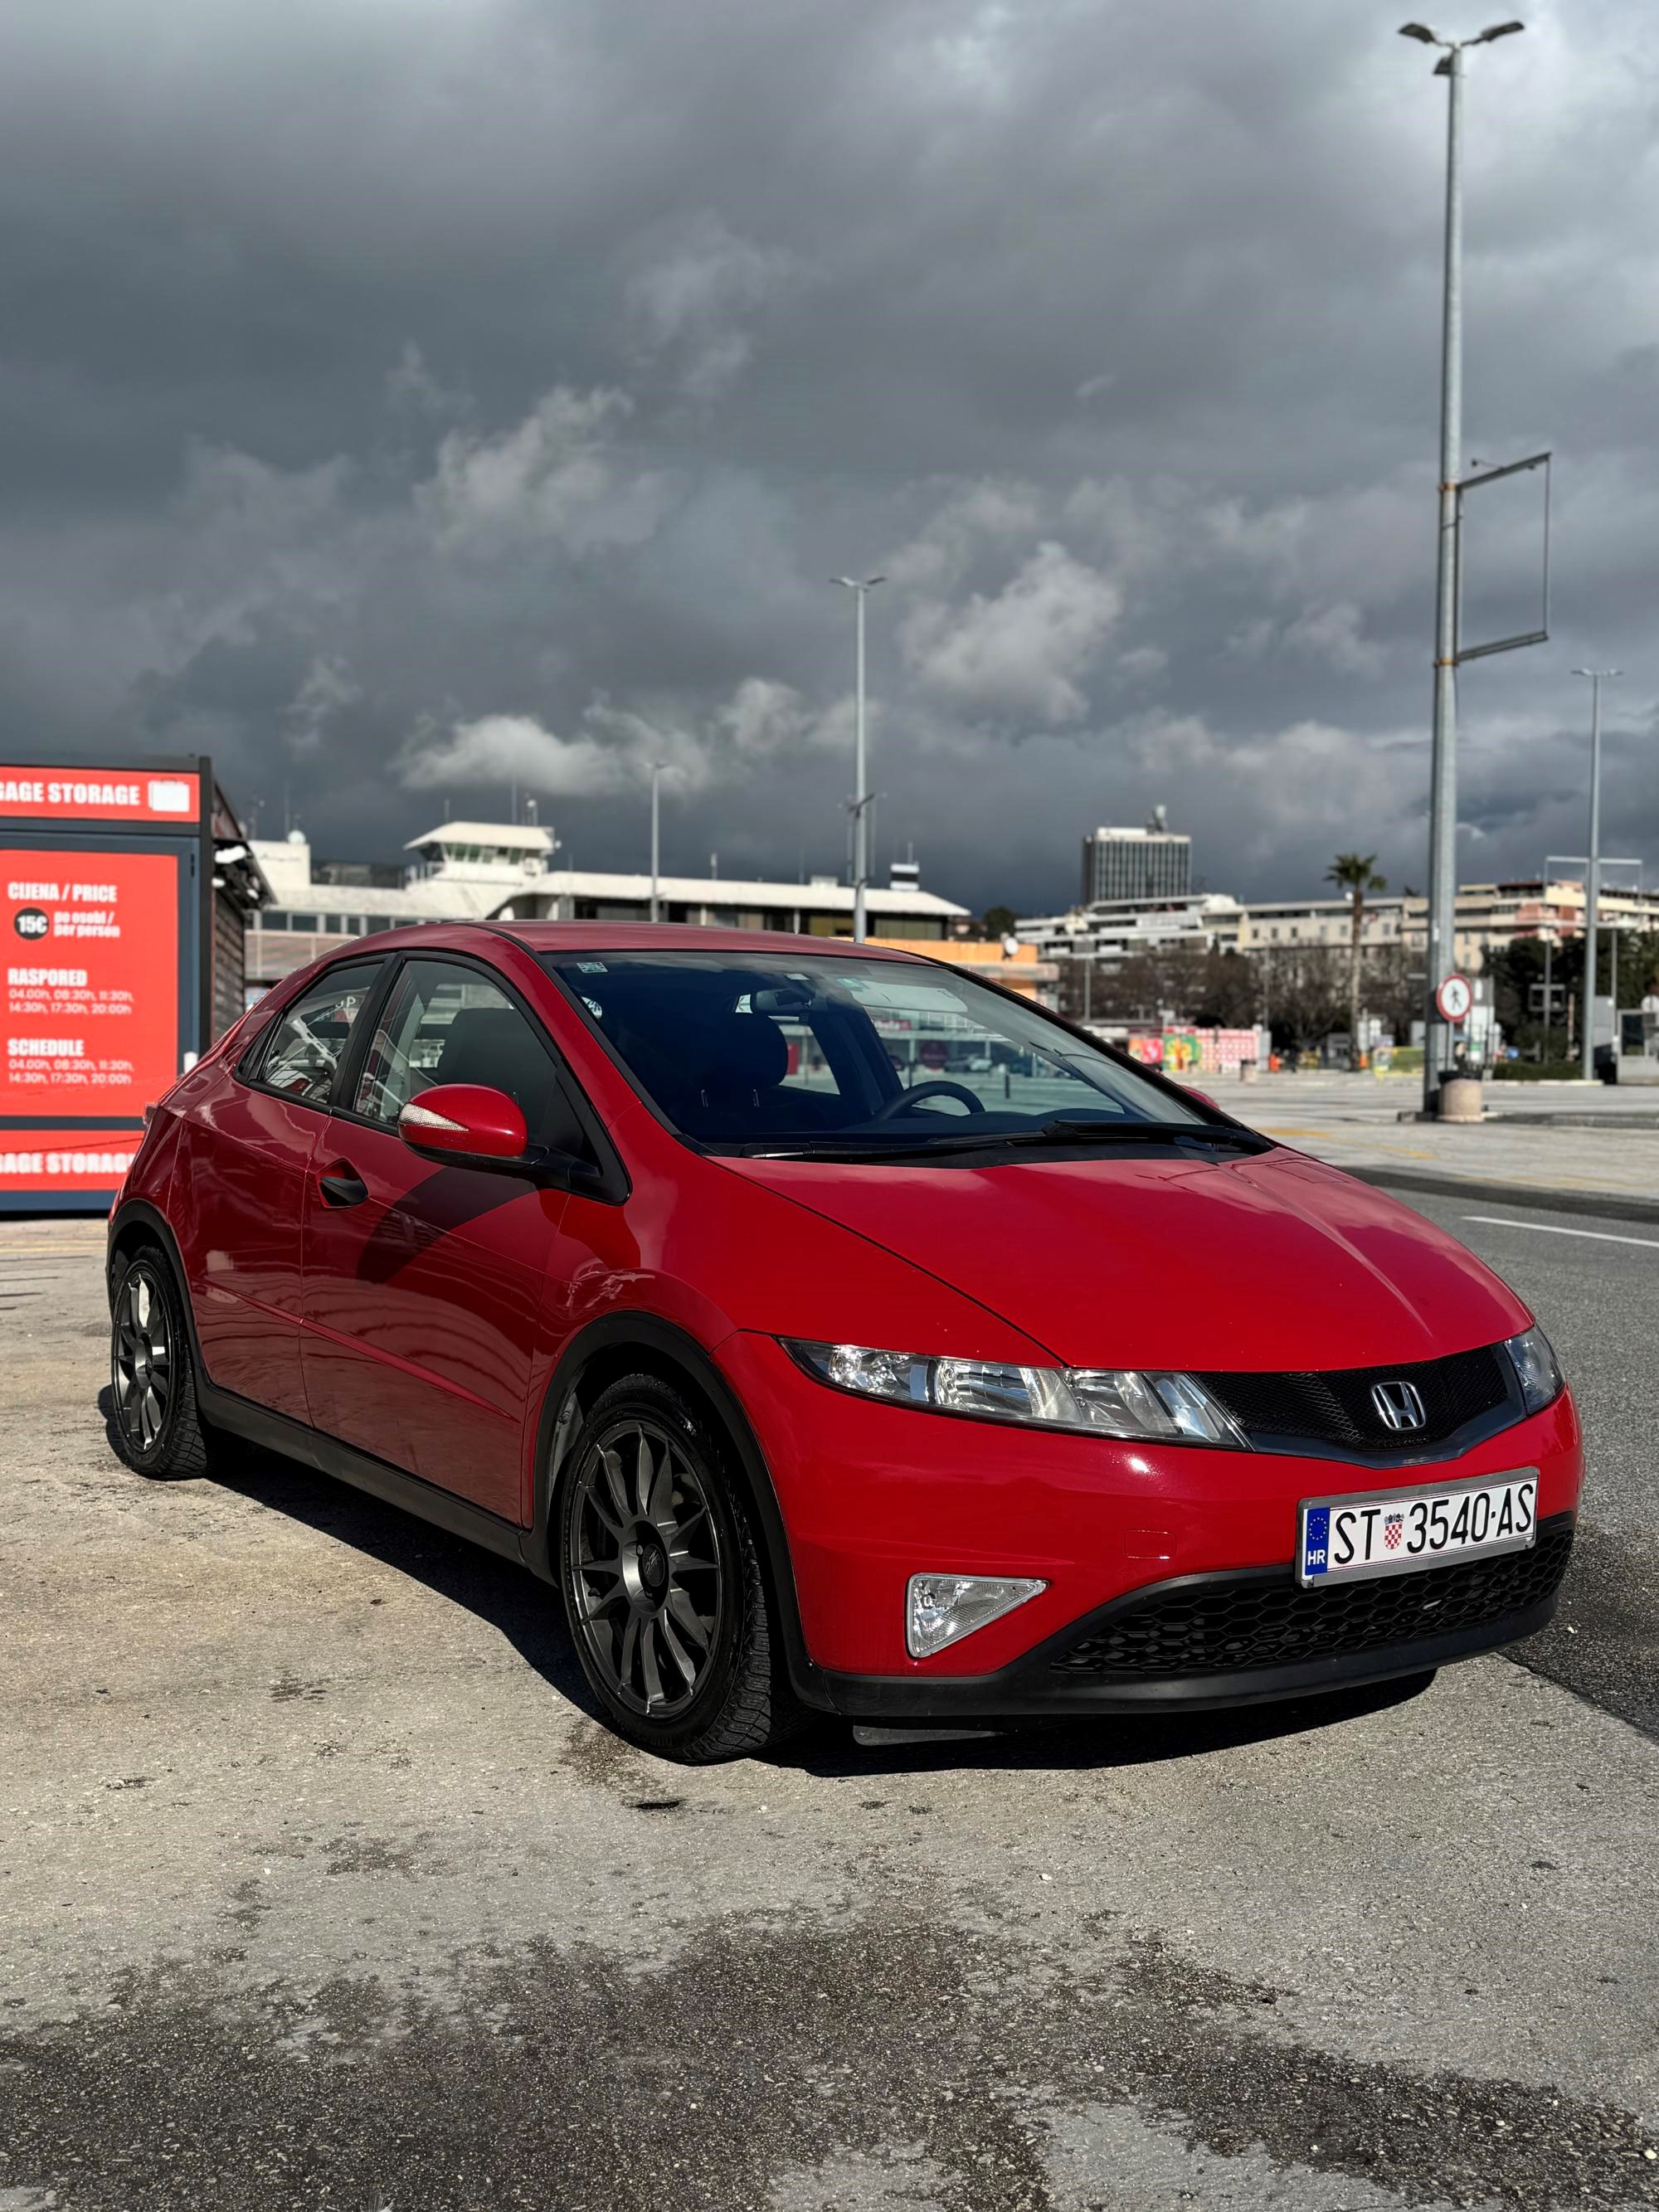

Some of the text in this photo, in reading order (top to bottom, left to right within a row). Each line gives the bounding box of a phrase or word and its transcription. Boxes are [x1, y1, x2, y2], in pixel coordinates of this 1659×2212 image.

[47, 782, 140, 805] STORAGE
[7, 882, 118, 903] CIJENA / PRICE
[54, 911, 71, 925] po
[54, 925, 121, 938] per person
[7, 968, 88, 987] RASPORED
[7, 1038, 85, 1057] SCHEDULE
[0, 1152, 44, 1174] AGE
[1333, 1508, 1382, 1565] ST
[1306, 1548, 1326, 1566] HR
